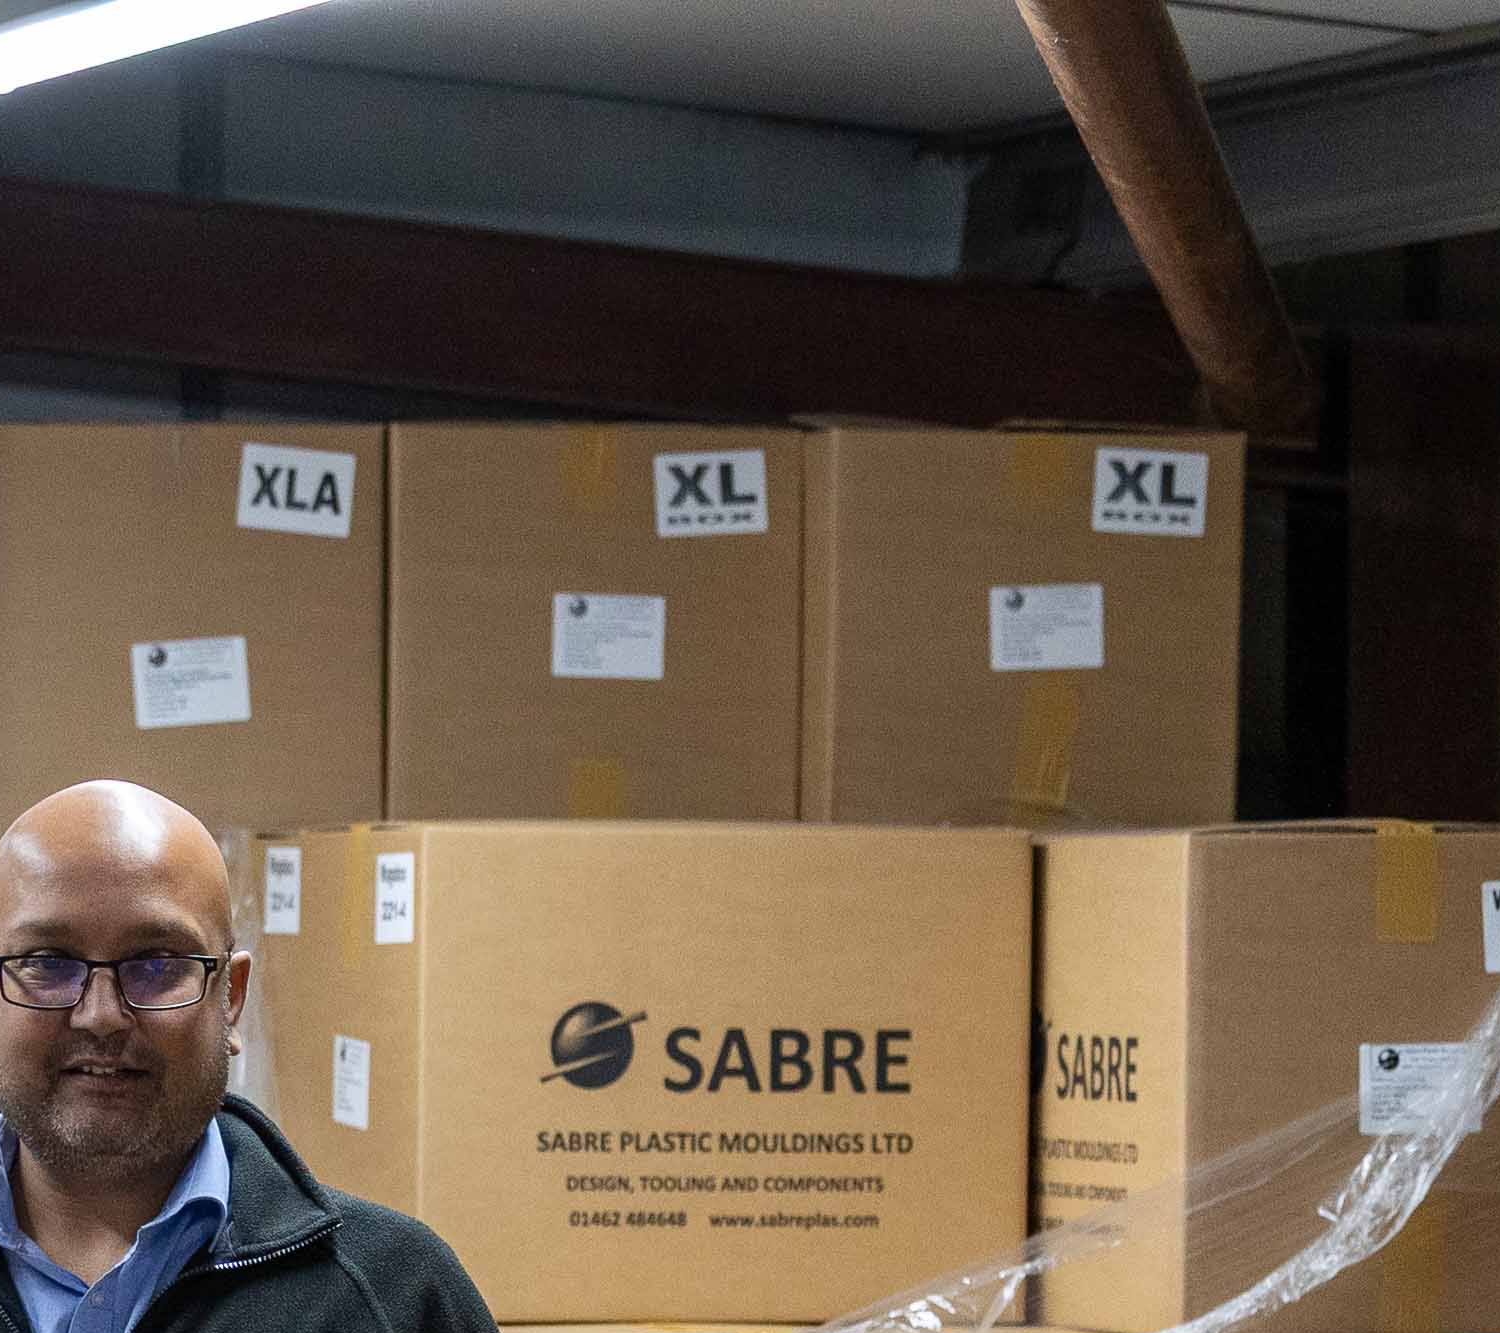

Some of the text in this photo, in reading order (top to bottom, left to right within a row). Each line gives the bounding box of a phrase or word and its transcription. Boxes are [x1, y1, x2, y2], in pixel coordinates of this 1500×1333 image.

[251, 464, 341, 516] XLA
[668, 462, 758, 507] XL
[1107, 459, 1197, 508] XL
[663, 1026, 912, 1094] SABRE
[1056, 1033, 1138, 1103] SABRE
[538, 1131, 914, 1155] SABRE PLASTIC MOULDINGS LTD
[566, 1176, 884, 1195] DESIGN, TOOLING AND COMPONENTS
[569, 1211, 879, 1231] 01462 484648 www.sabreplas.com
